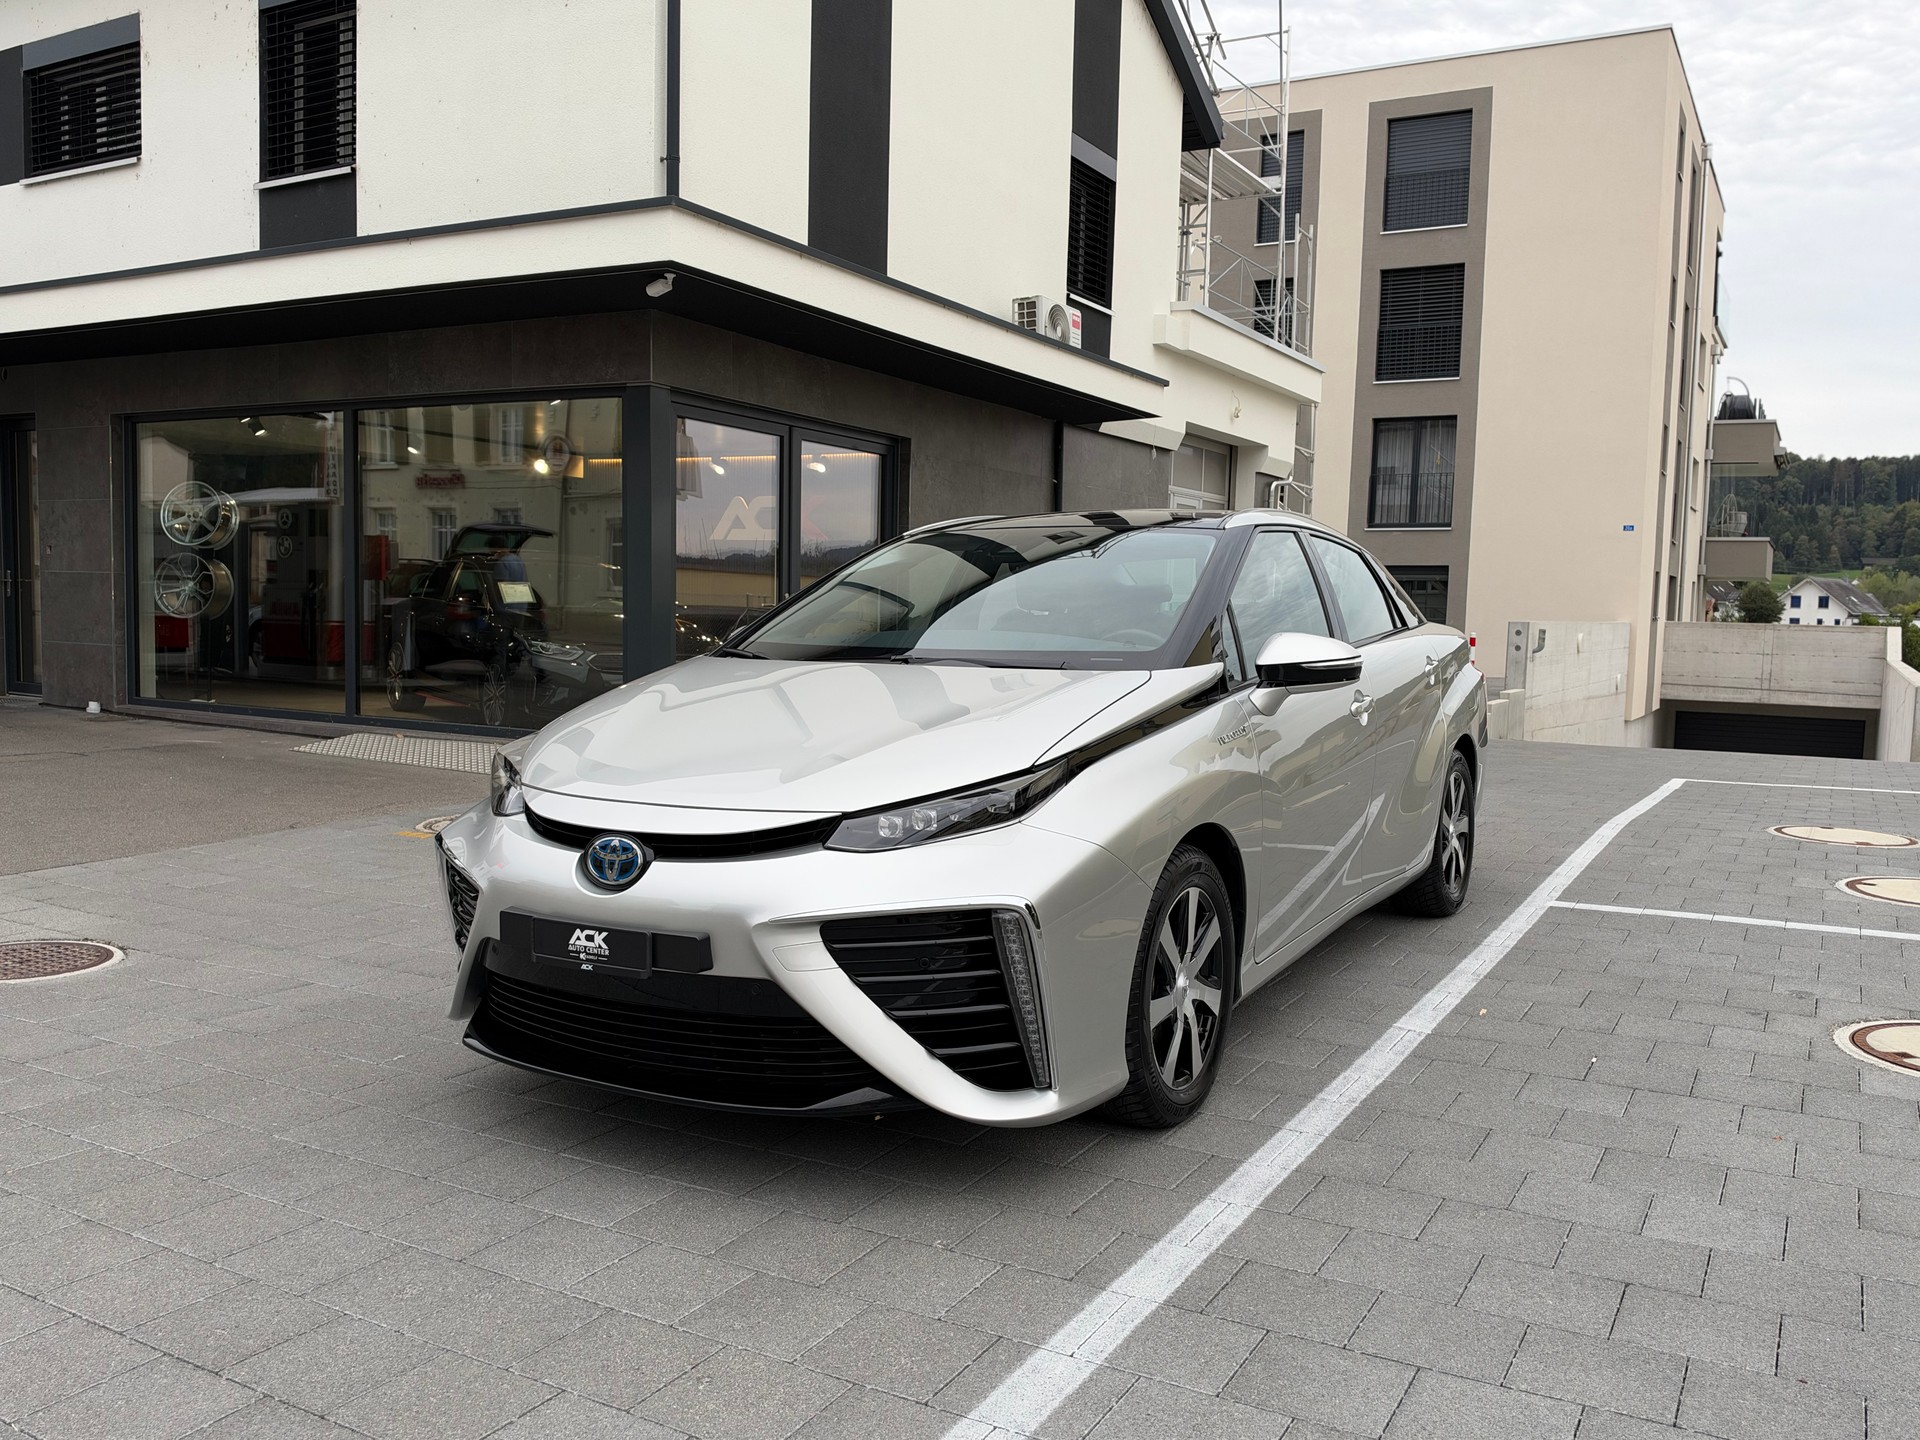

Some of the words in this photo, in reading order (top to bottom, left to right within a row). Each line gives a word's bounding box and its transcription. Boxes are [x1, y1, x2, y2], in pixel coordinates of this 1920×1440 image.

[568, 928, 609, 949] ACK
[568, 944, 585, 952] AUTO
[585, 946, 610, 956] CENTER
[580, 963, 594, 971] ACK
